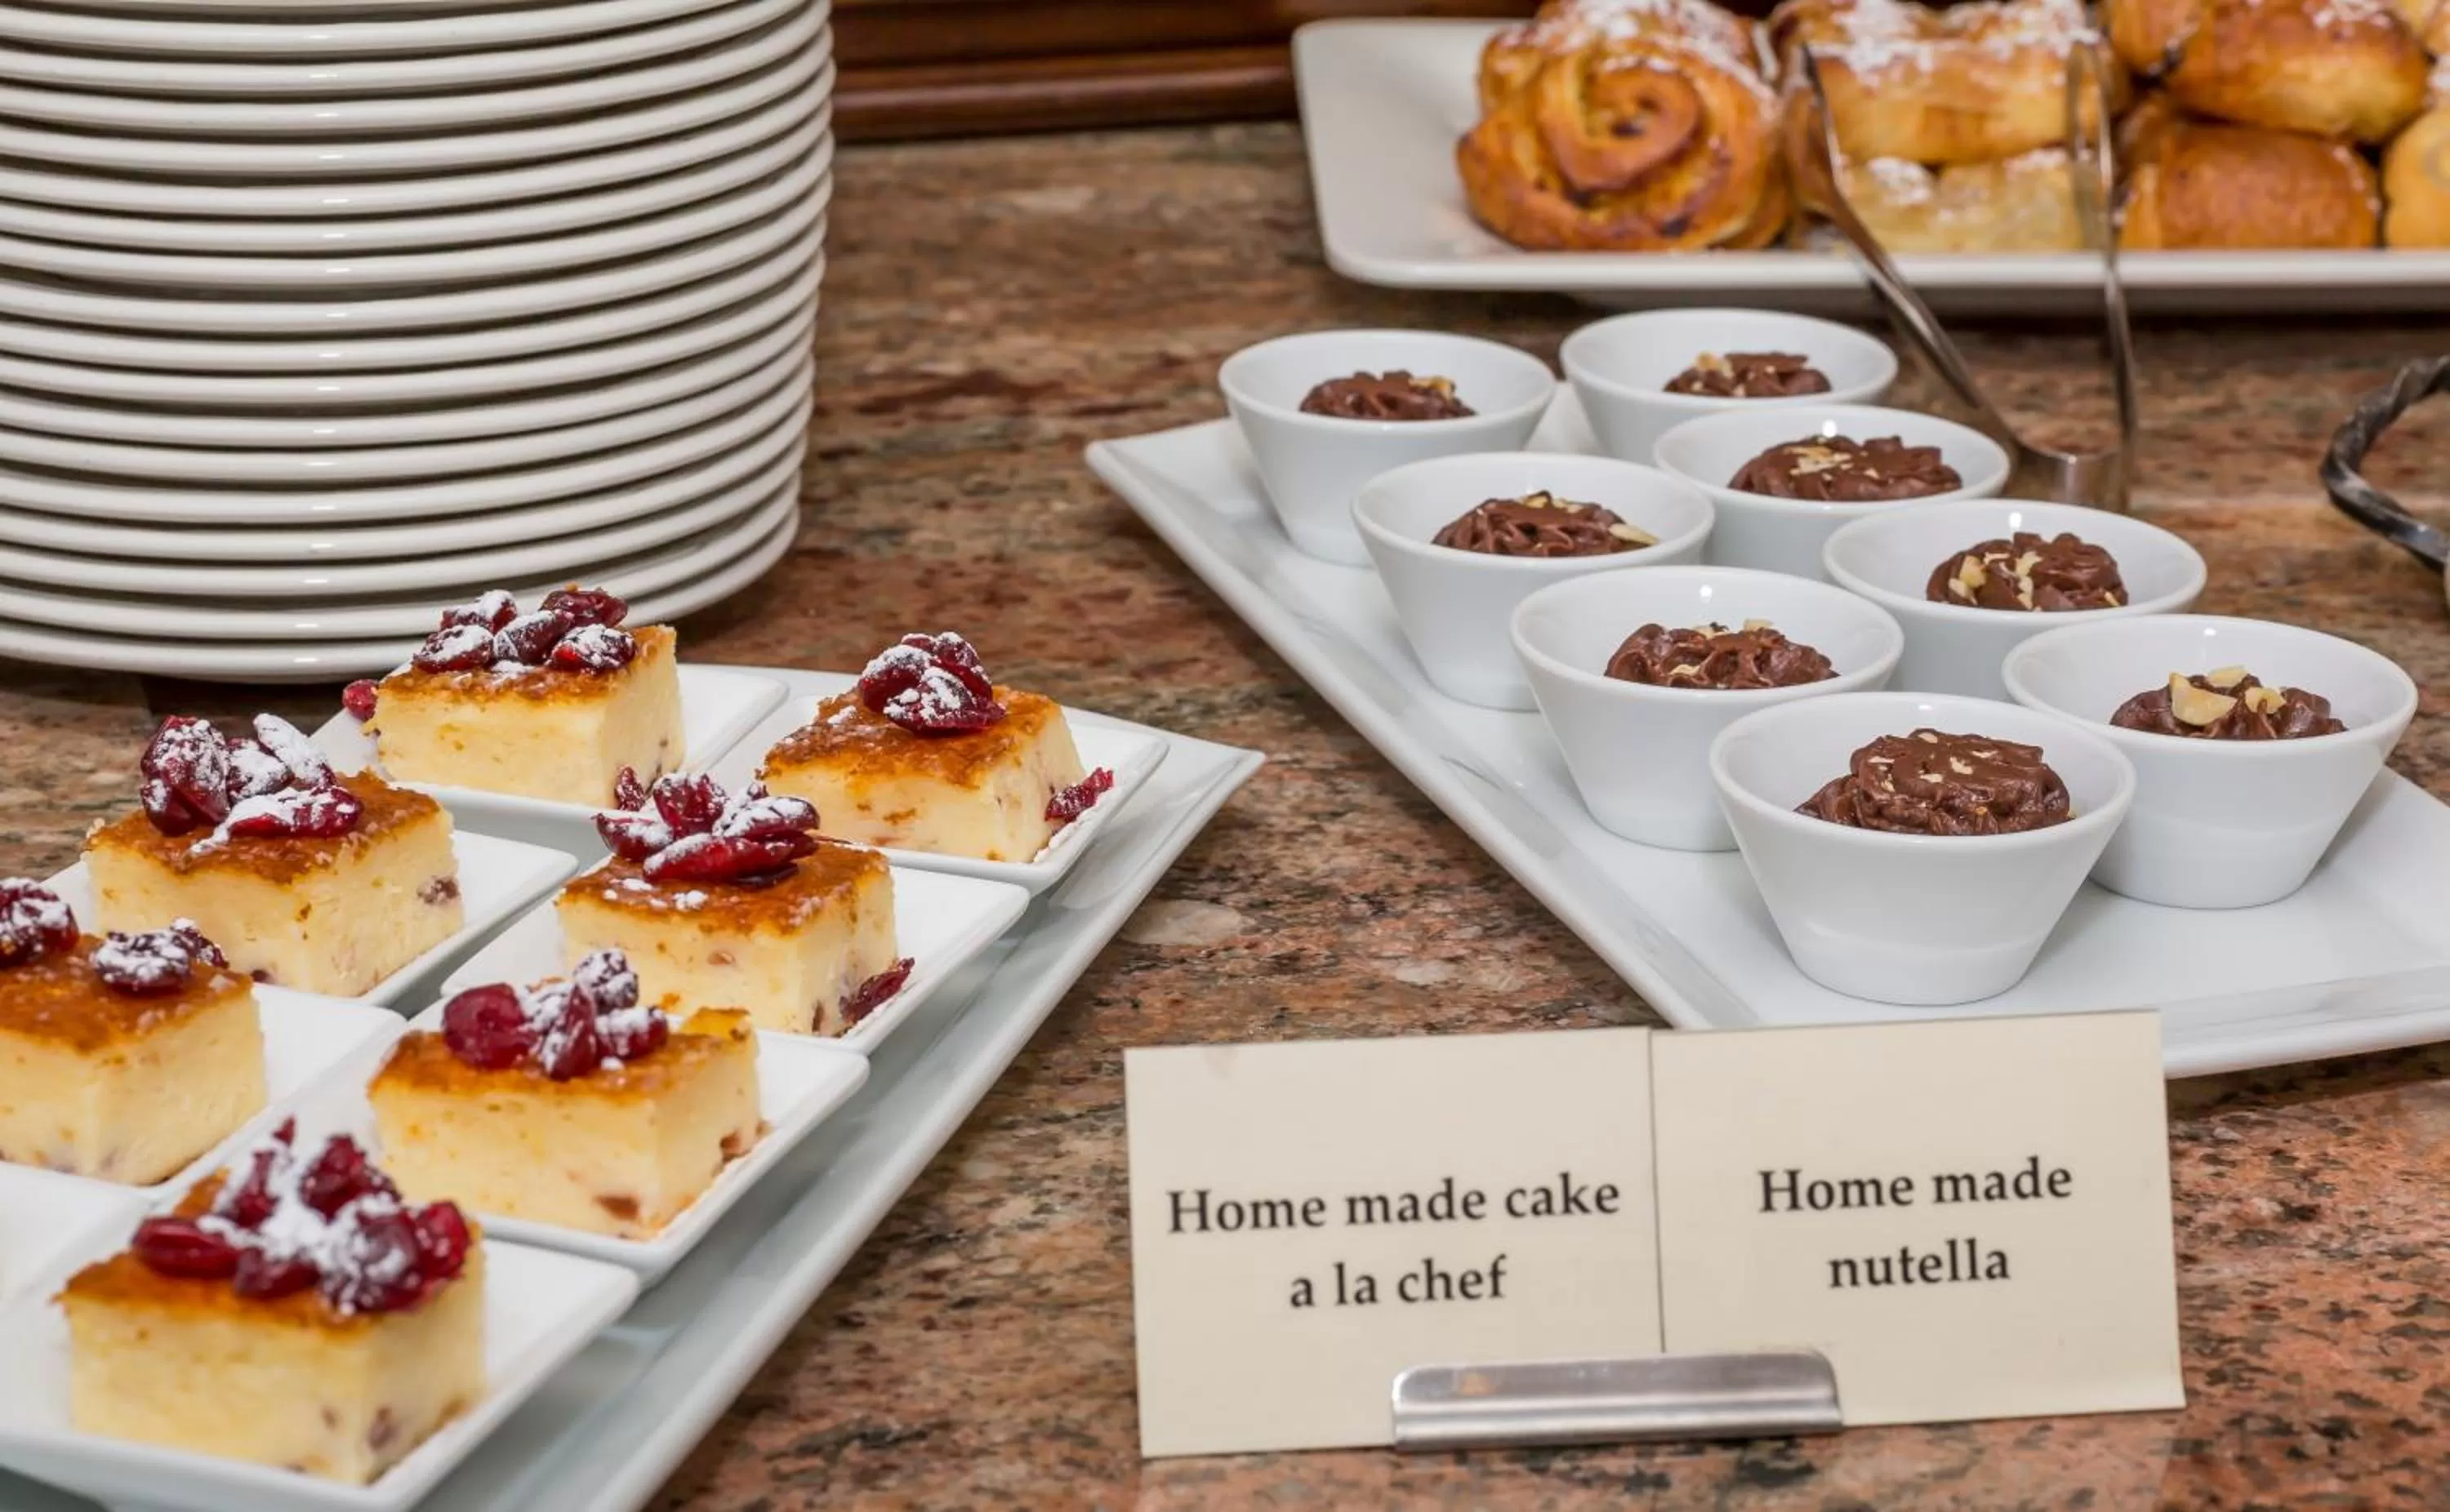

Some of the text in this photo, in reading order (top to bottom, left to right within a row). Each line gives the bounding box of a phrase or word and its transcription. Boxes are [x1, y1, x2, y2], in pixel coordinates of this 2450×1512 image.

[1168, 1170, 1621, 1234] Home made cake
[1757, 1154, 2074, 1214] Home made
[1289, 1252, 1508, 1310] a la chef
[1827, 1236, 2011, 1290] nutella
